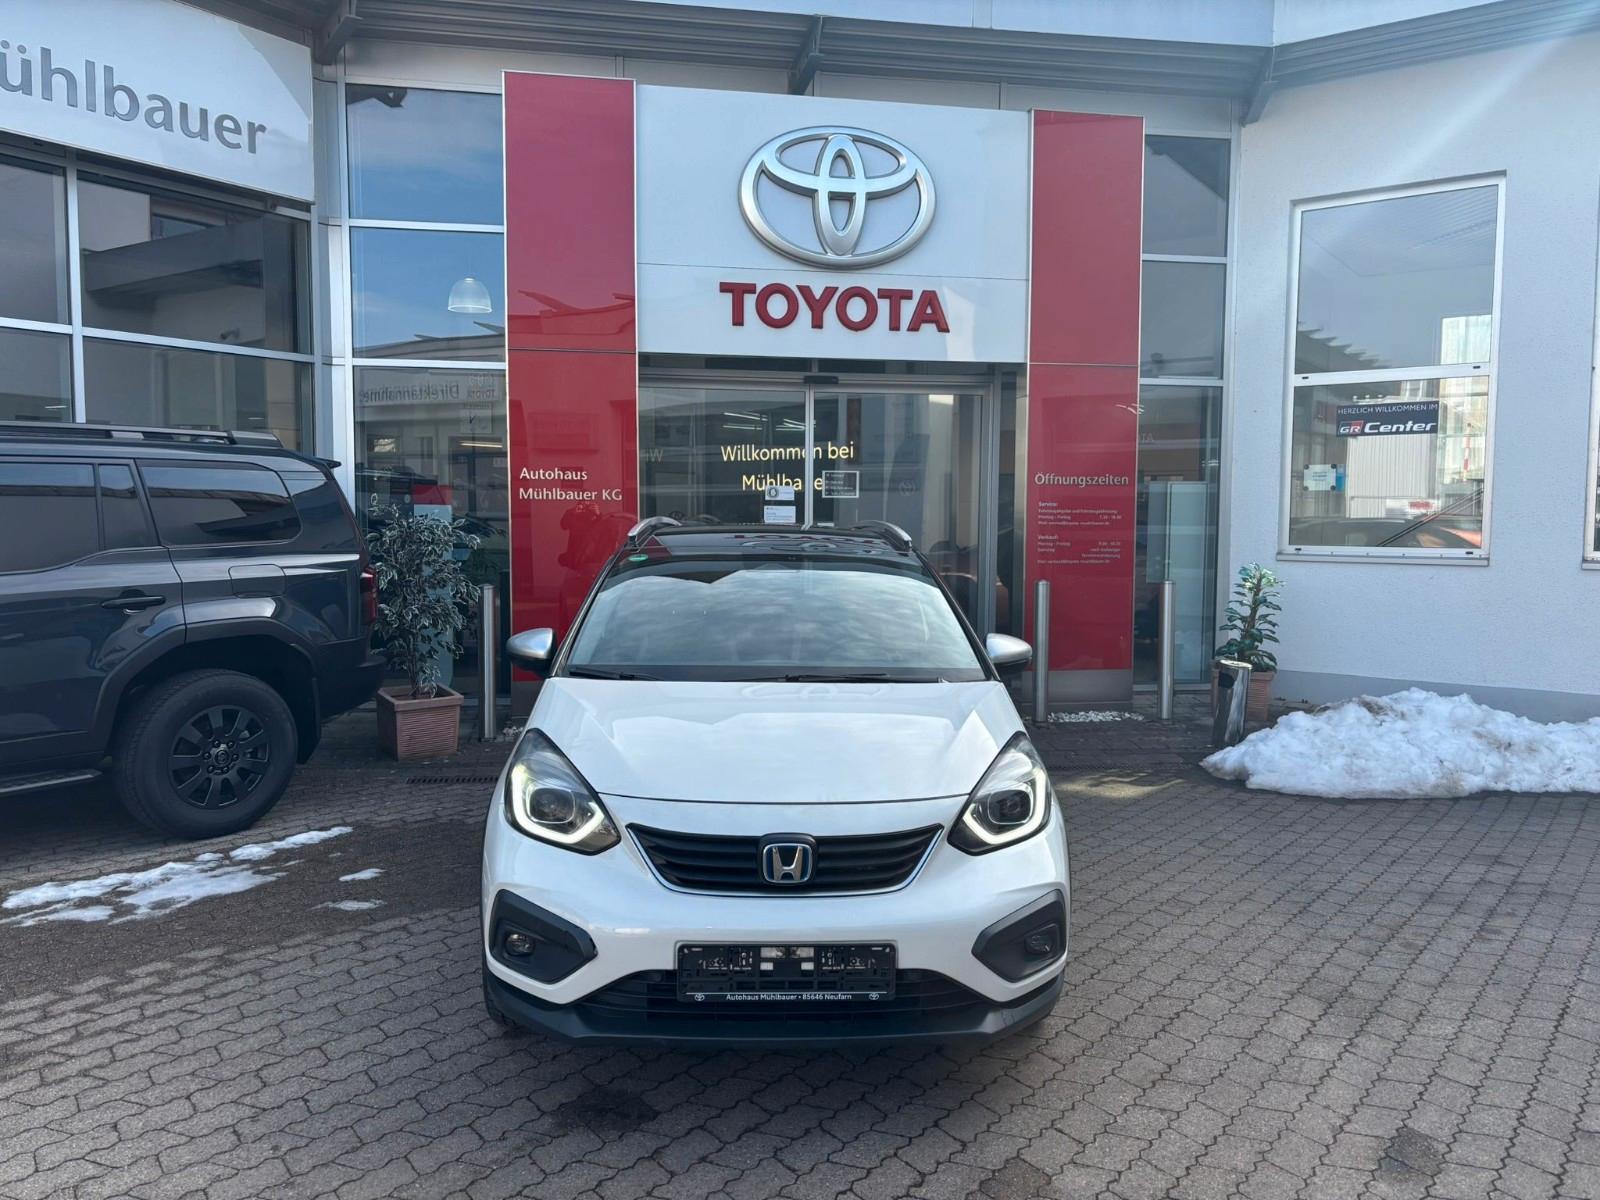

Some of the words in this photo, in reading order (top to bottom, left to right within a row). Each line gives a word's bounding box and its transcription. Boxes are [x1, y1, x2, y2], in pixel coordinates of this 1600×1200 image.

[719, 281, 950, 333] TOYOTA
[1338, 407, 1373, 415] HERZLICH
[1375, 404, 1427, 413] WILLKOMMEN
[1364, 420, 1437, 433] Center
[827, 441, 854, 459] bei
[519, 467, 588, 480] Autohaus
[1034, 472, 1129, 488] Öffnungszeiten
[519, 487, 598, 500] Mühlbauer
[602, 488, 622, 501] KG
